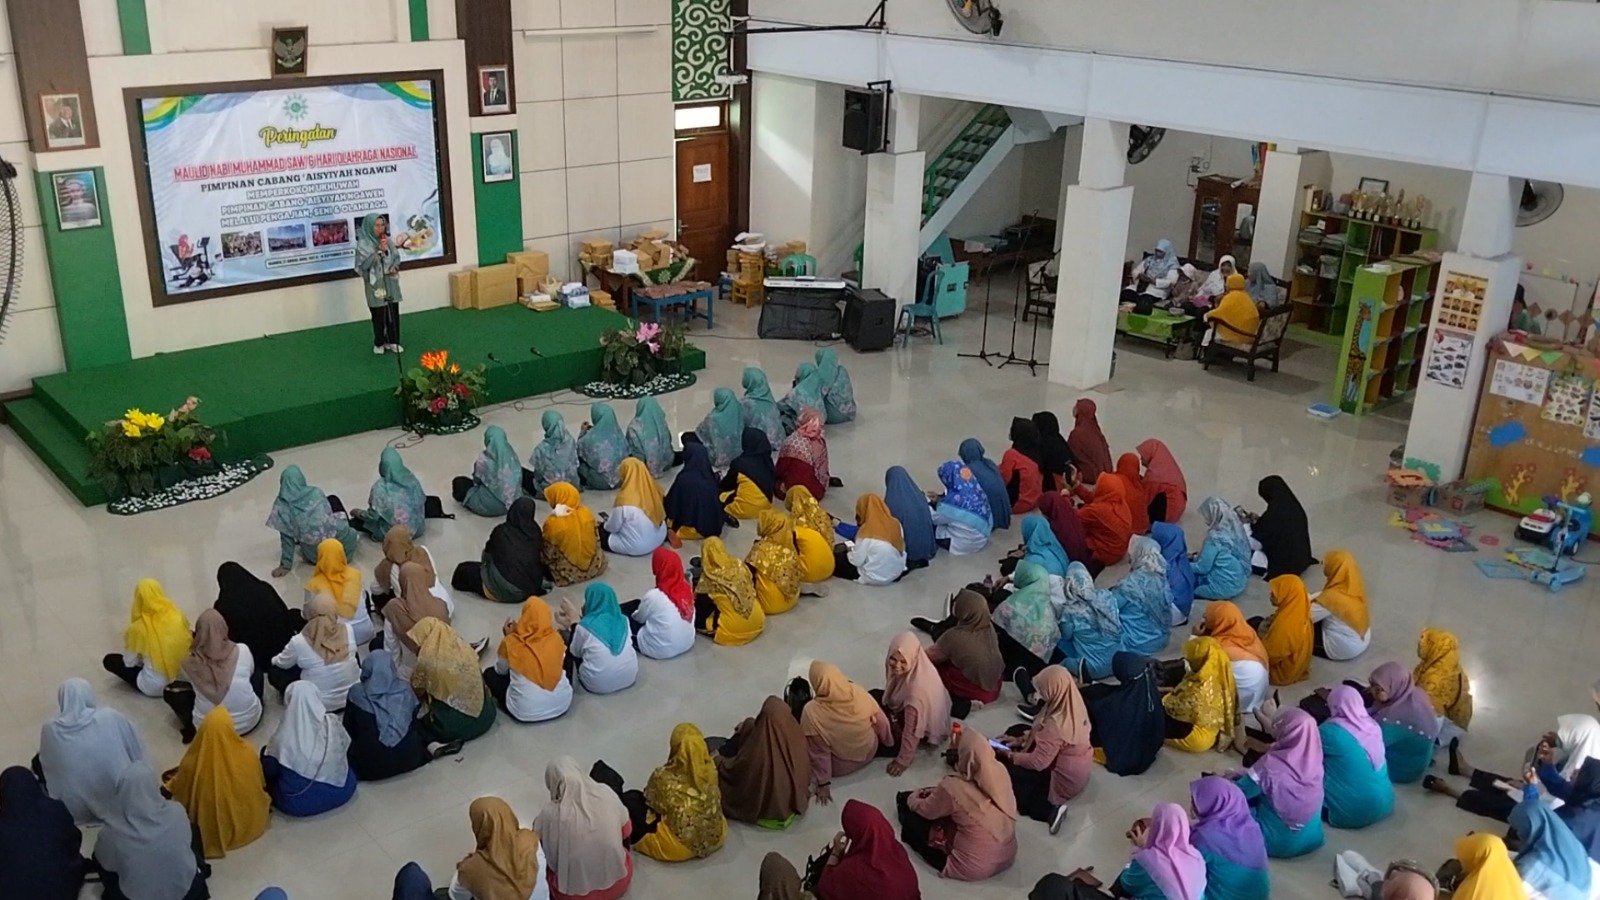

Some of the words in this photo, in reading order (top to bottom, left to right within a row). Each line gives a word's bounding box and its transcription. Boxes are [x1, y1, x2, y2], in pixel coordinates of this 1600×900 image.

[258, 123, 337, 148] Peringatan
[174, 166, 209, 181] MAULID
[209, 161, 231, 178] NABI
[232, 157, 286, 176] MUHAMMAD
[287, 155, 306, 171] SAW
[316, 152, 336, 168] HARI
[336, 150, 378, 165] OLAHRAGA
[380, 147, 417, 161] NASIONAL
[201, 179, 255, 192] PIMPINAN
[257, 174, 301, 187] CABANG
[355, 164, 397, 176] NGAWEN
[246, 185, 315, 199] MEMPERKOKOH
[316, 180, 359, 193] UKHUWAH
[221, 201, 266, 216] PIMPINAN
[267, 196, 304, 210] CABANG
[347, 188, 385, 200] NGAWEN
[221, 215, 260, 228] MELALUI
[313, 204, 333, 216] SENI
[341, 201, 387, 212] OLAHRAGA
